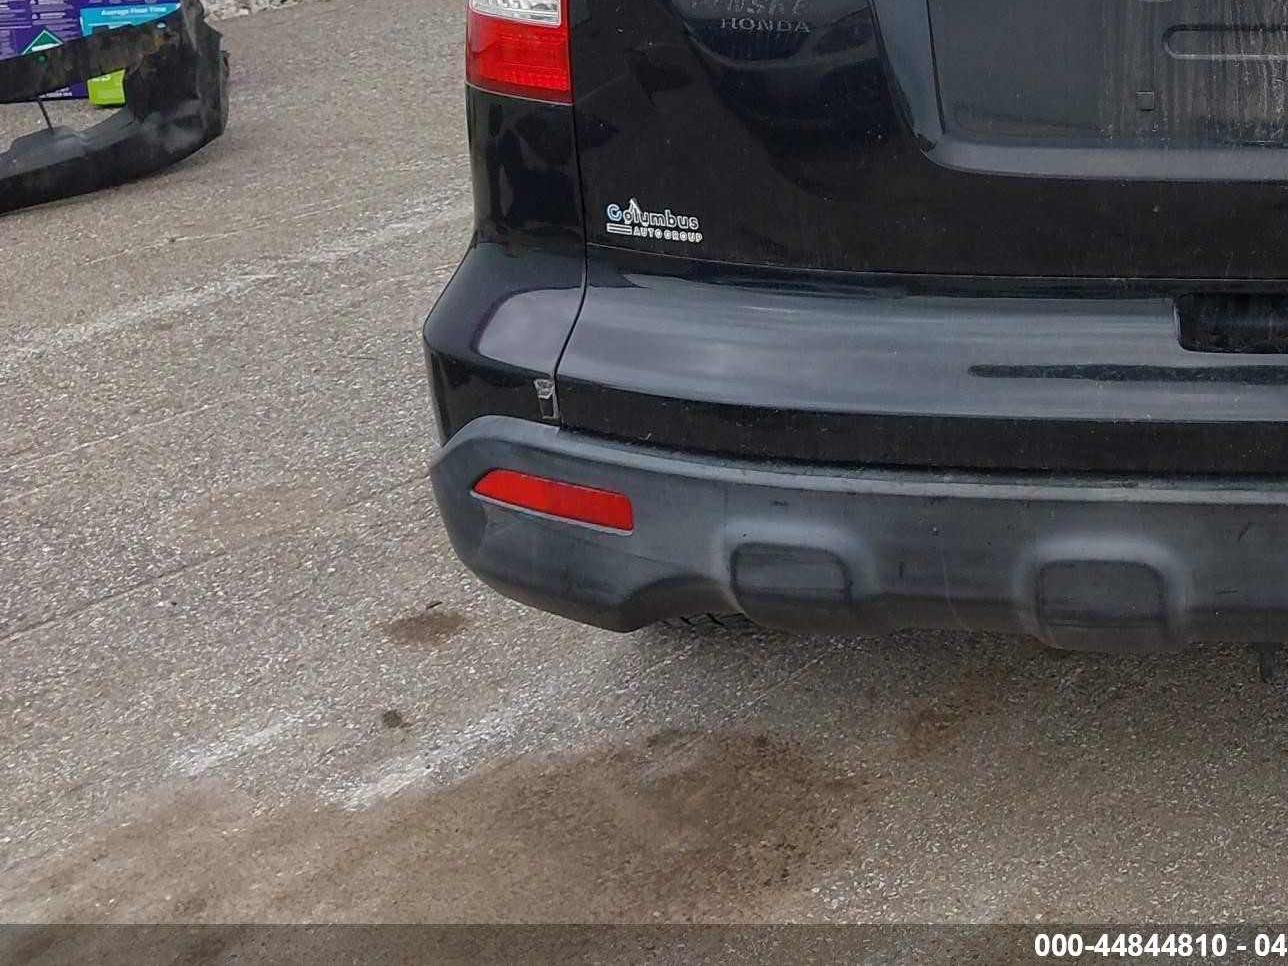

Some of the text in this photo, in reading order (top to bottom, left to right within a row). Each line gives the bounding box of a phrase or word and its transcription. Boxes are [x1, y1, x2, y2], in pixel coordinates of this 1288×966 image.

[720, 15, 811, 33] HONDA
[606, 197, 699, 230] Columbus
[633, 225, 703, 243] AUTO GROUP
